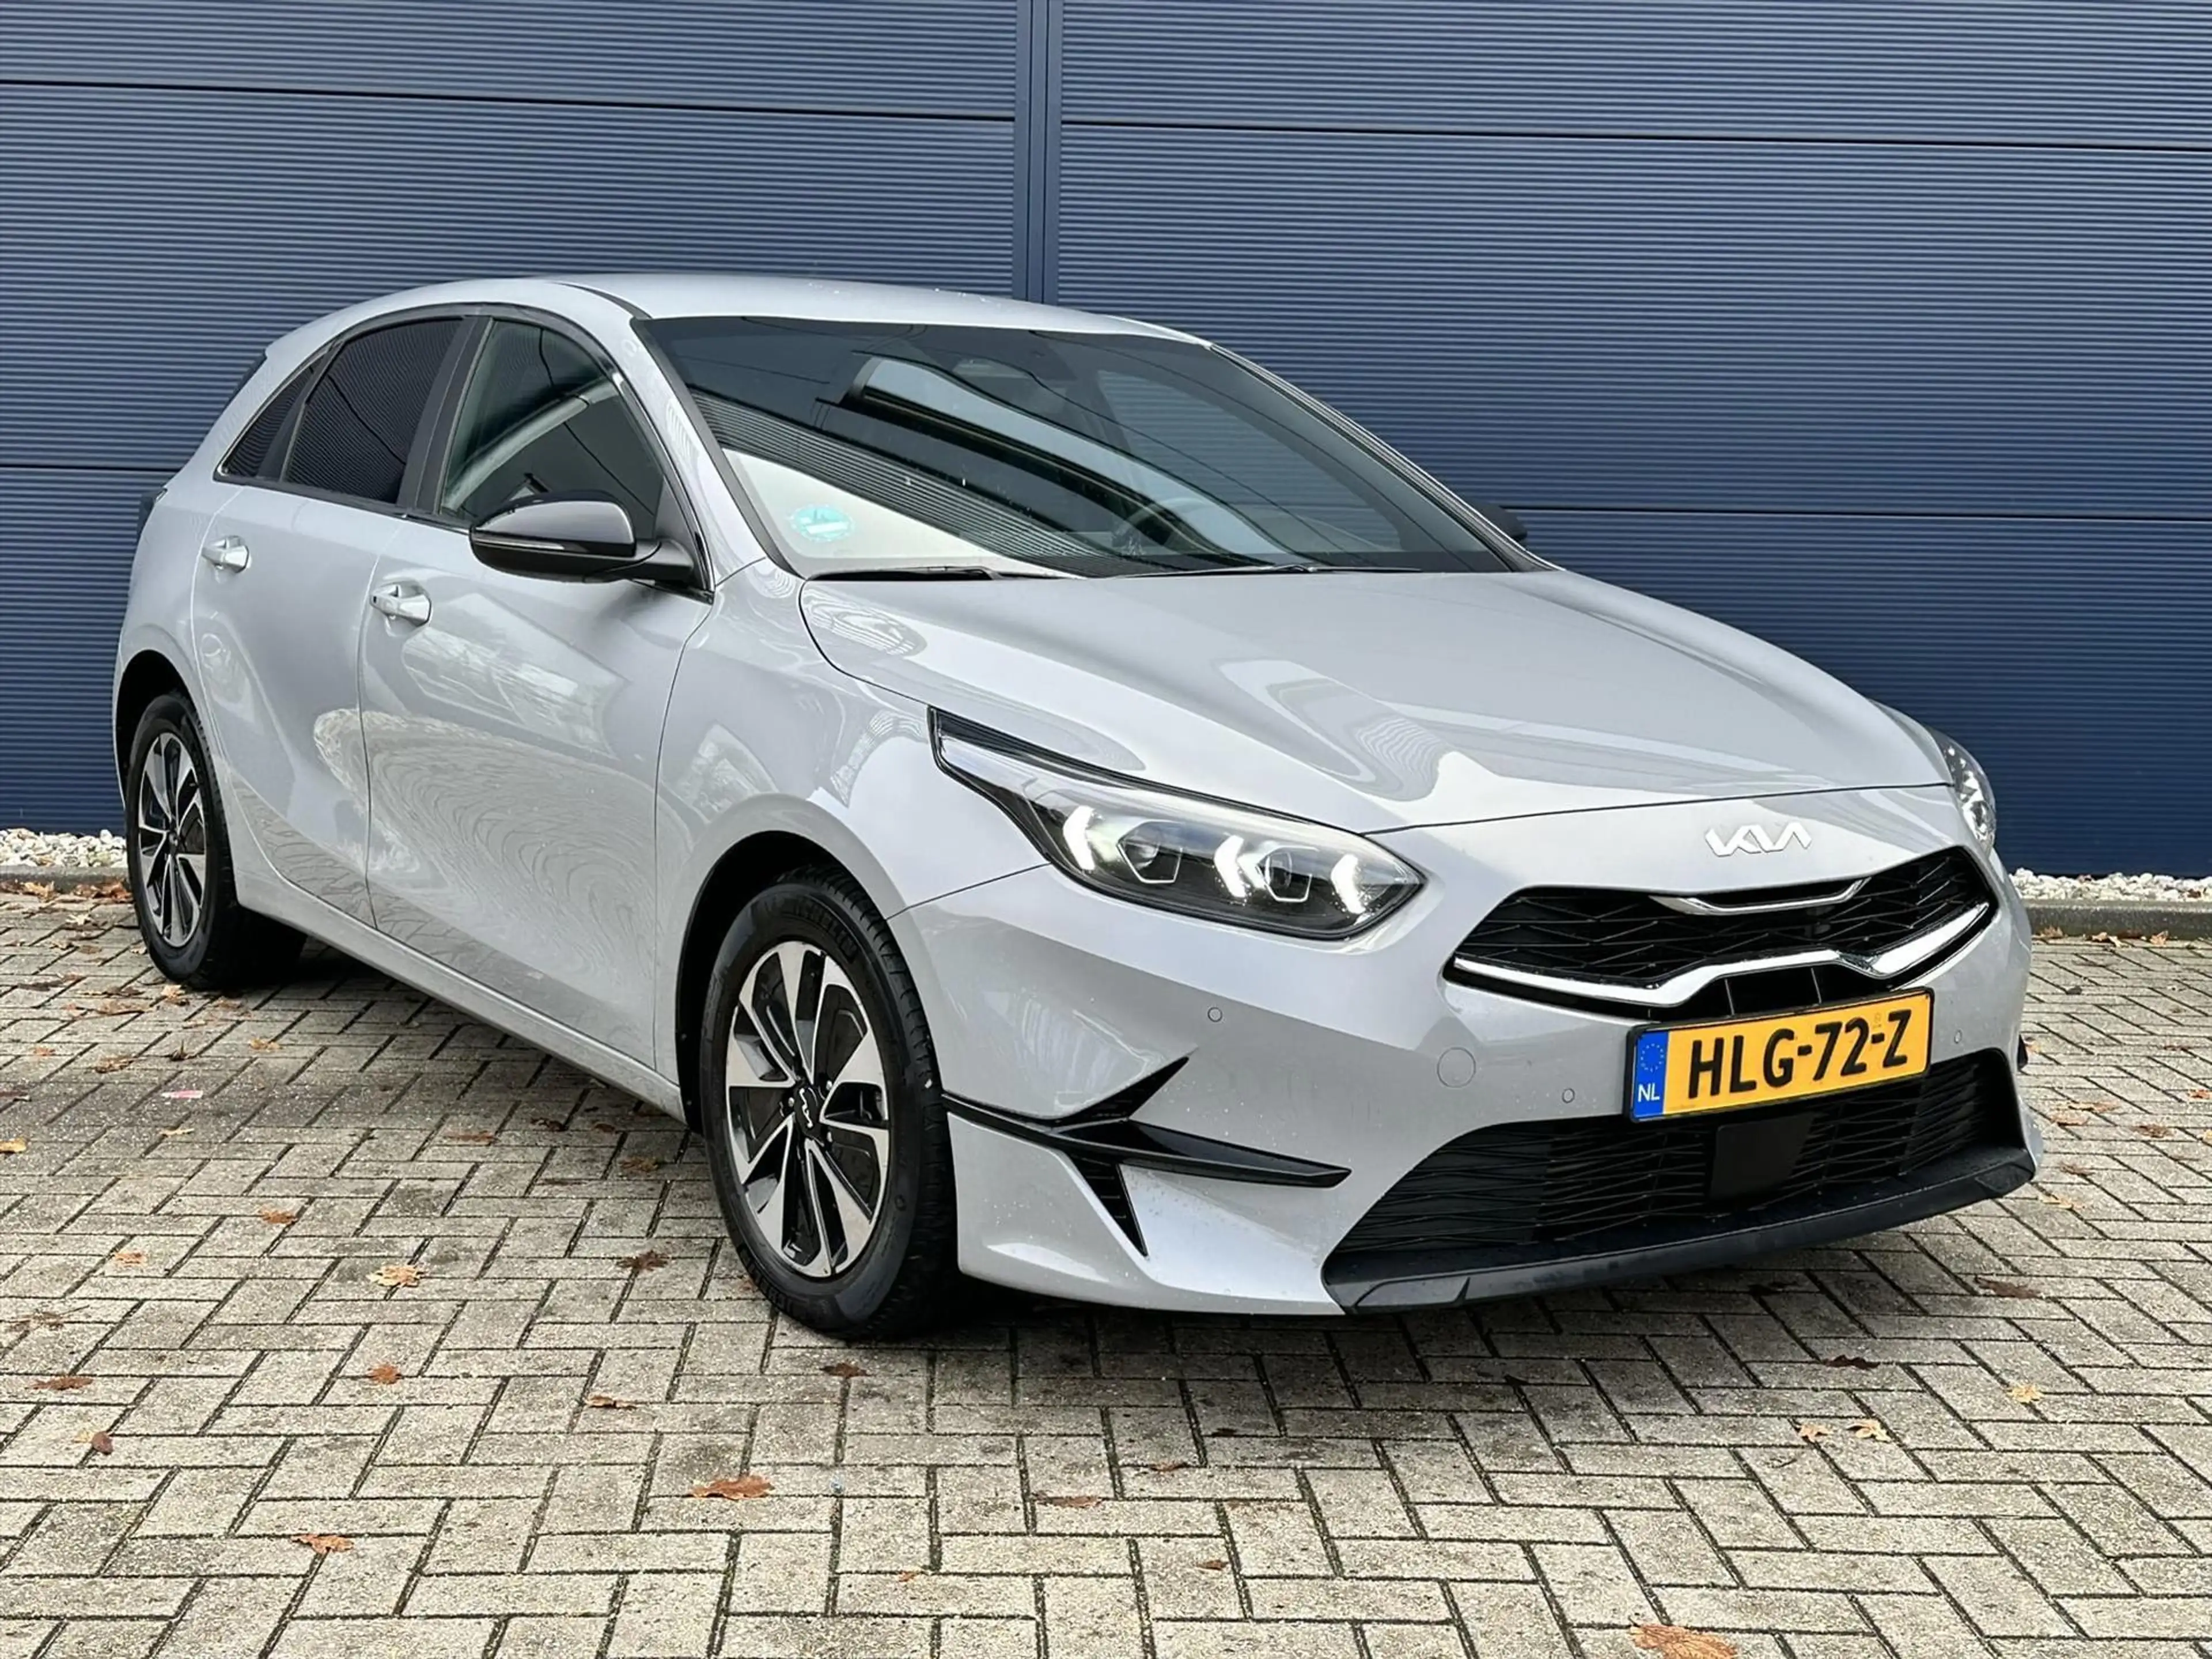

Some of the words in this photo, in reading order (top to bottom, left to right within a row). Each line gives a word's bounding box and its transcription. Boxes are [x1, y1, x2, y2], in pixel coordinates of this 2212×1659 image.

[1705, 821, 1813, 858] KIA
[1687, 1009, 1912, 1099] HLG-72-Z
[1638, 1082, 1660, 1103] NL
